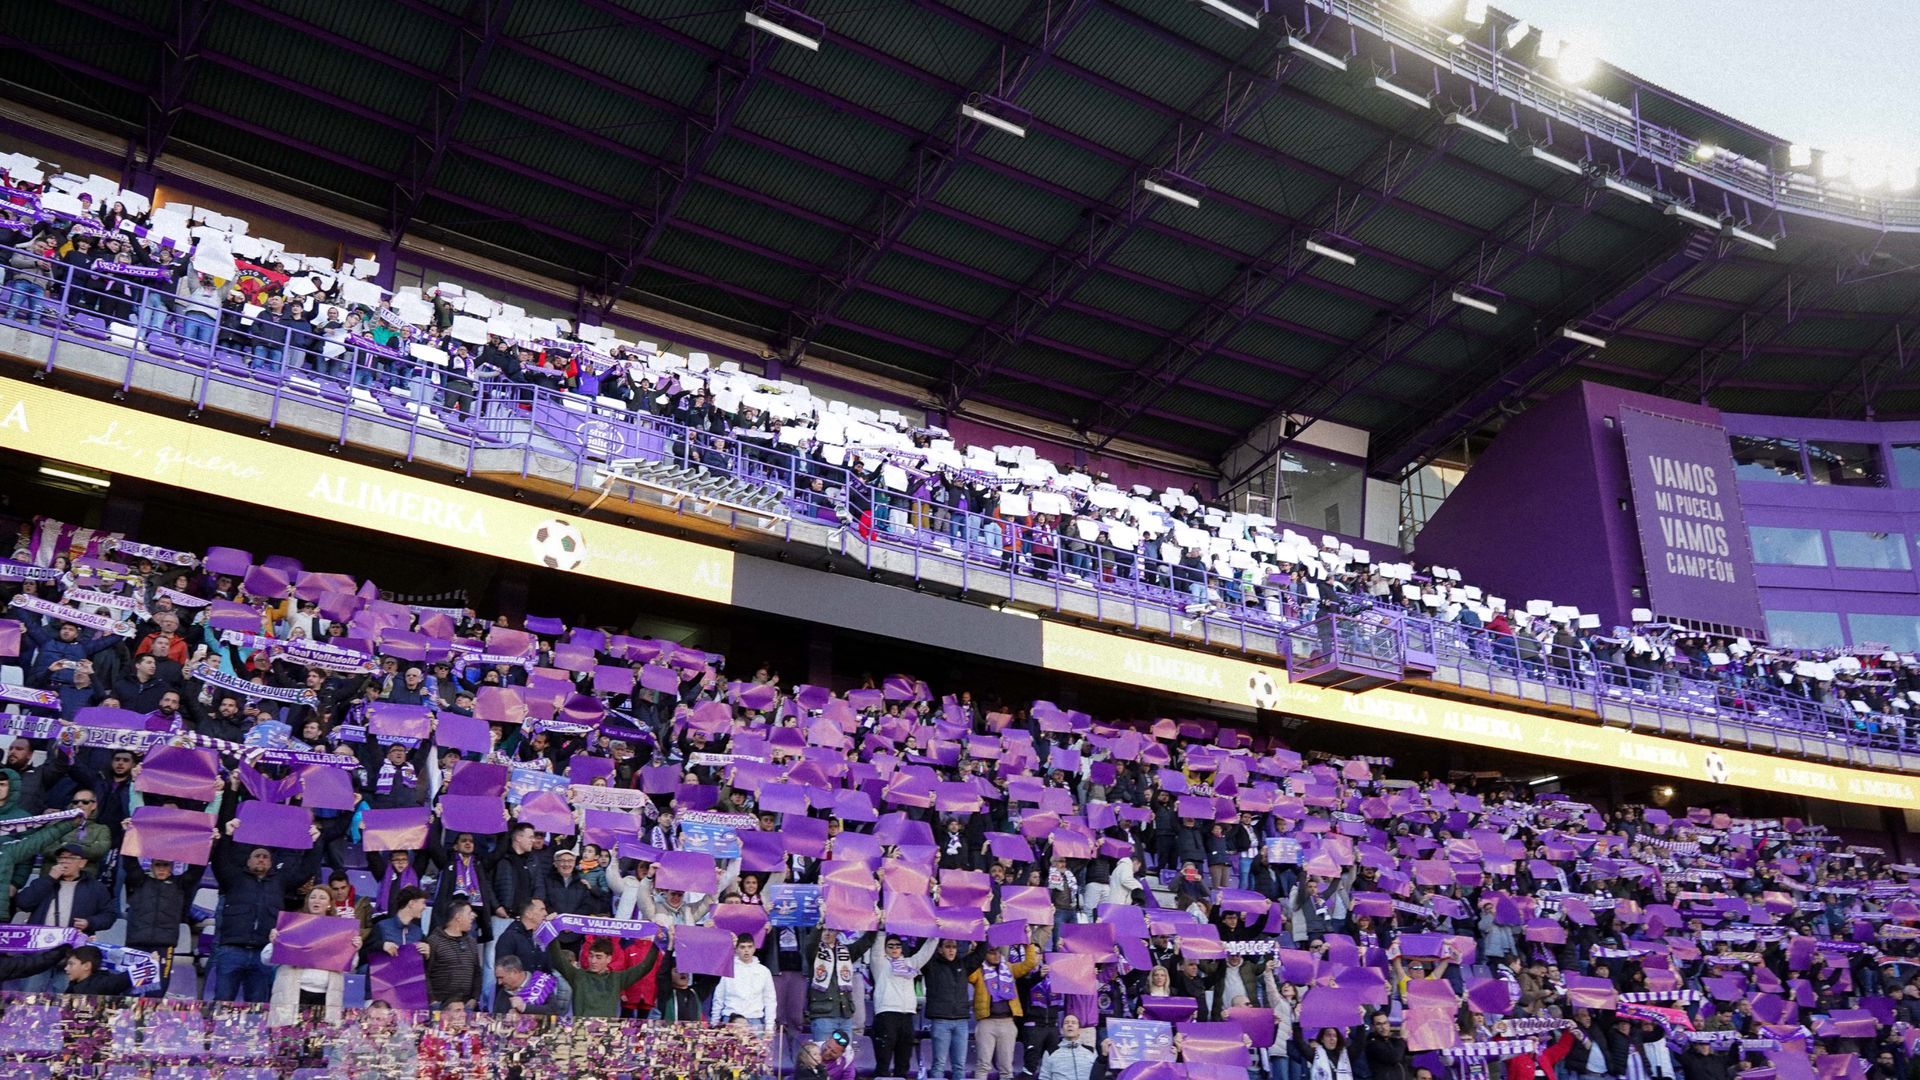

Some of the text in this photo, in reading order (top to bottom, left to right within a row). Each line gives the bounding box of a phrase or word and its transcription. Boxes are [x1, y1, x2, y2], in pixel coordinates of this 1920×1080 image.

[1649, 455, 1719, 496] VAMOS
[306, 472, 488, 539] ALIMERKA
[1655, 490, 1725, 522] MI PUCELA
[1659, 516, 1729, 557] VAMOS
[1666, 551, 1736, 584] CAMPEÓN
[35, 600, 108, 627] REAL VALLADOLID
[287, 646, 310, 658] Real
[312, 651, 361, 666] Valladolid
[1123, 650, 1223, 688] ALIMERKA
[213, 671, 296, 698] REAL VALLADOLID
[345, 730, 366, 738] REAL
[561, 916, 642, 931] REAL VALLADOLID
